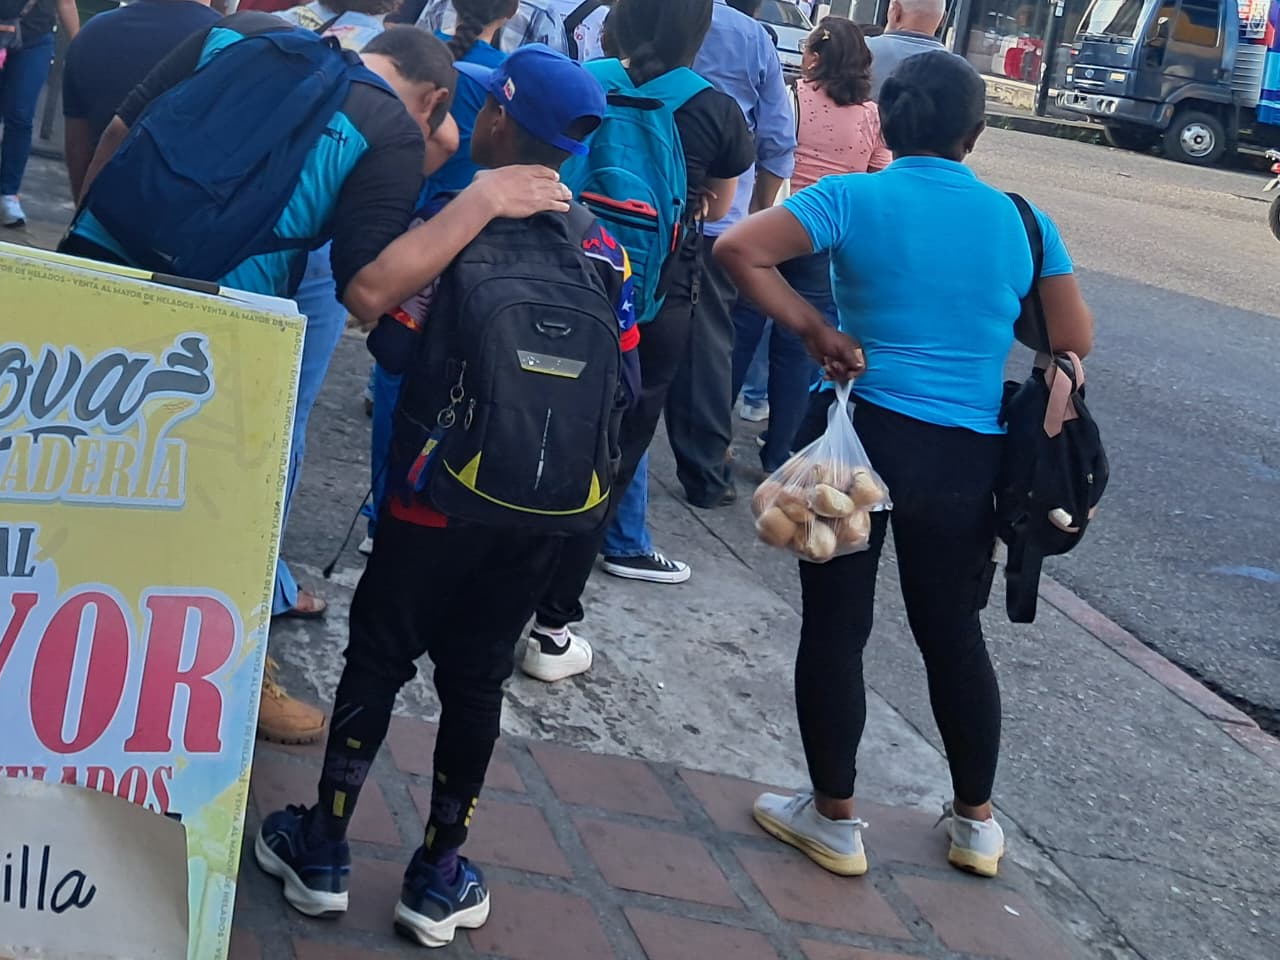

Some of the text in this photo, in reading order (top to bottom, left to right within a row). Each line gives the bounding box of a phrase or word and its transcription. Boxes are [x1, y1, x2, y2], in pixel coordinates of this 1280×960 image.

[27, 269, 65, 283] HELADOS
[72, 278, 98, 290] VENTA
[100, 284, 111, 292] AL
[113, 286, 142, 298] MAYOR
[143, 292, 154, 301] DE
[155, 295, 194, 309] HELADOS
[201, 304, 227, 315] VENTA
[229, 310, 240, 318] AL
